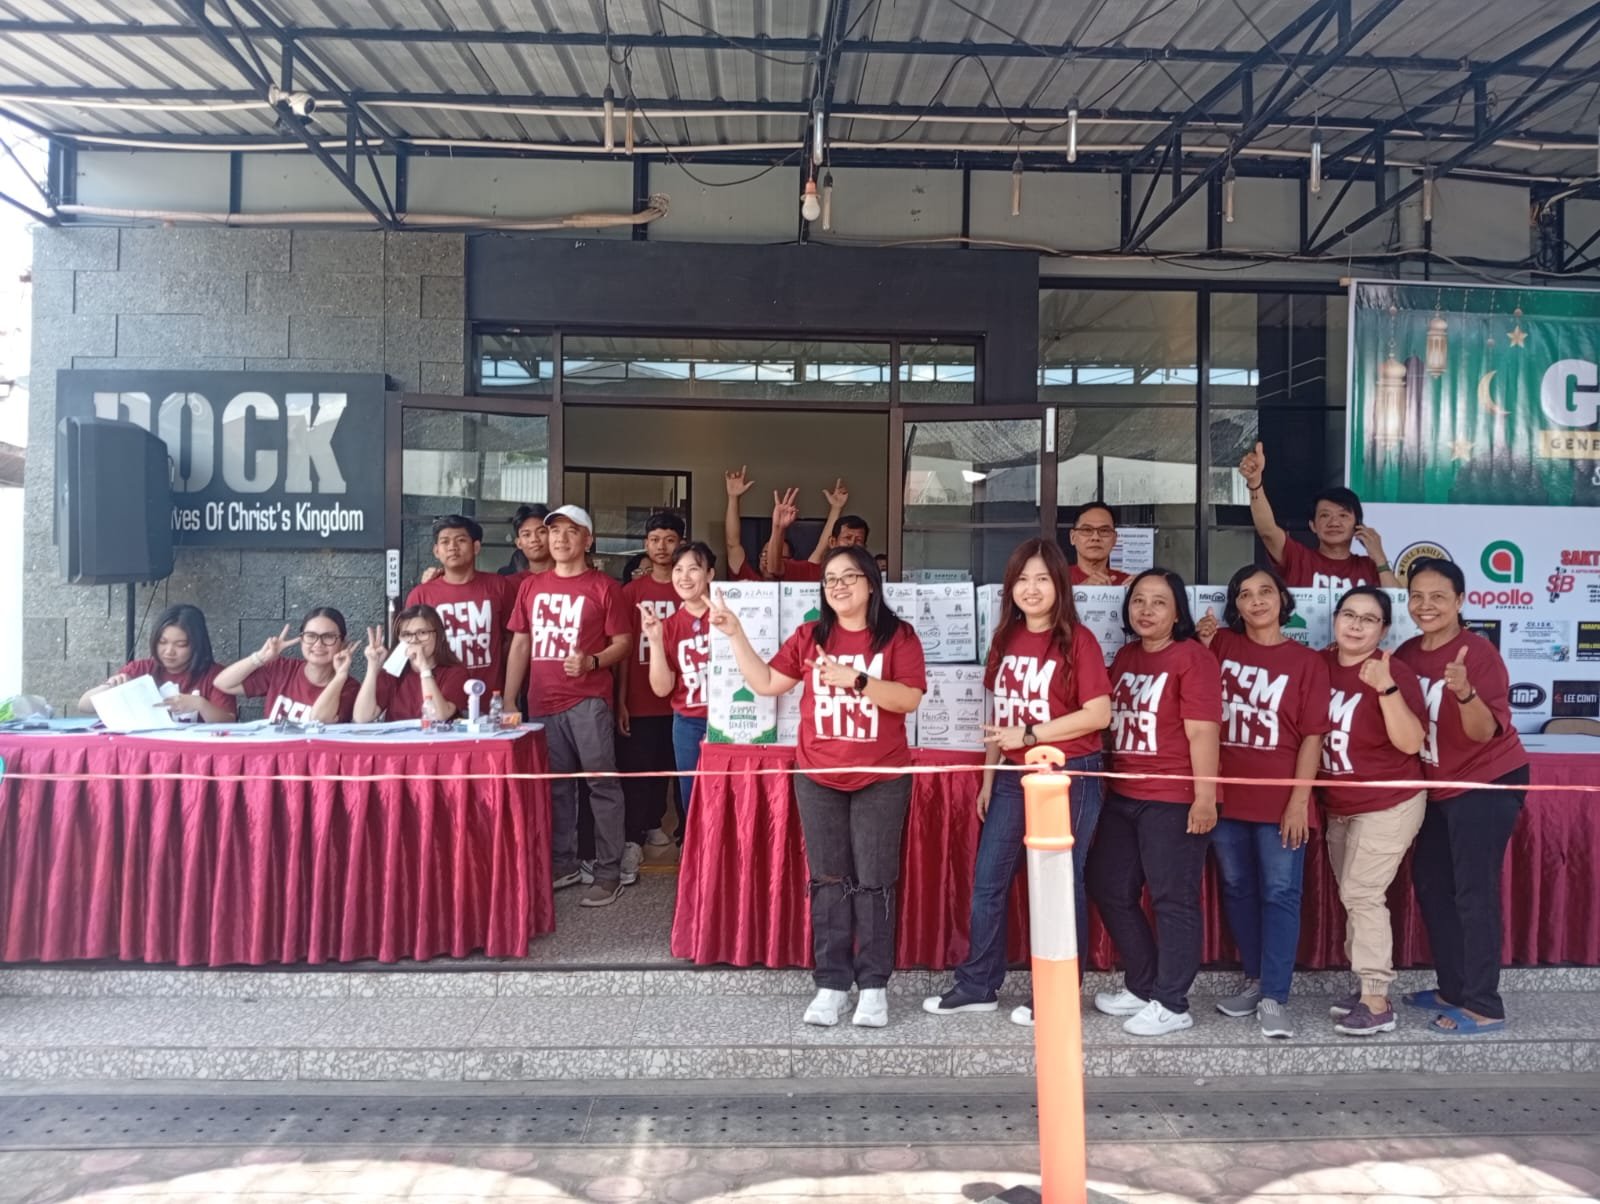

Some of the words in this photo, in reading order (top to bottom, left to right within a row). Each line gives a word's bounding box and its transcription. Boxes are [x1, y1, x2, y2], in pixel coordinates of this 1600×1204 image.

[94, 392, 347, 494] OCK
[205, 502, 225, 532] Of
[228, 503, 291, 532] Christ's
[296, 503, 364, 538] Kingdom
[1468, 589, 1534, 608] apollo
[1563, 694, 1576, 703] LEE
